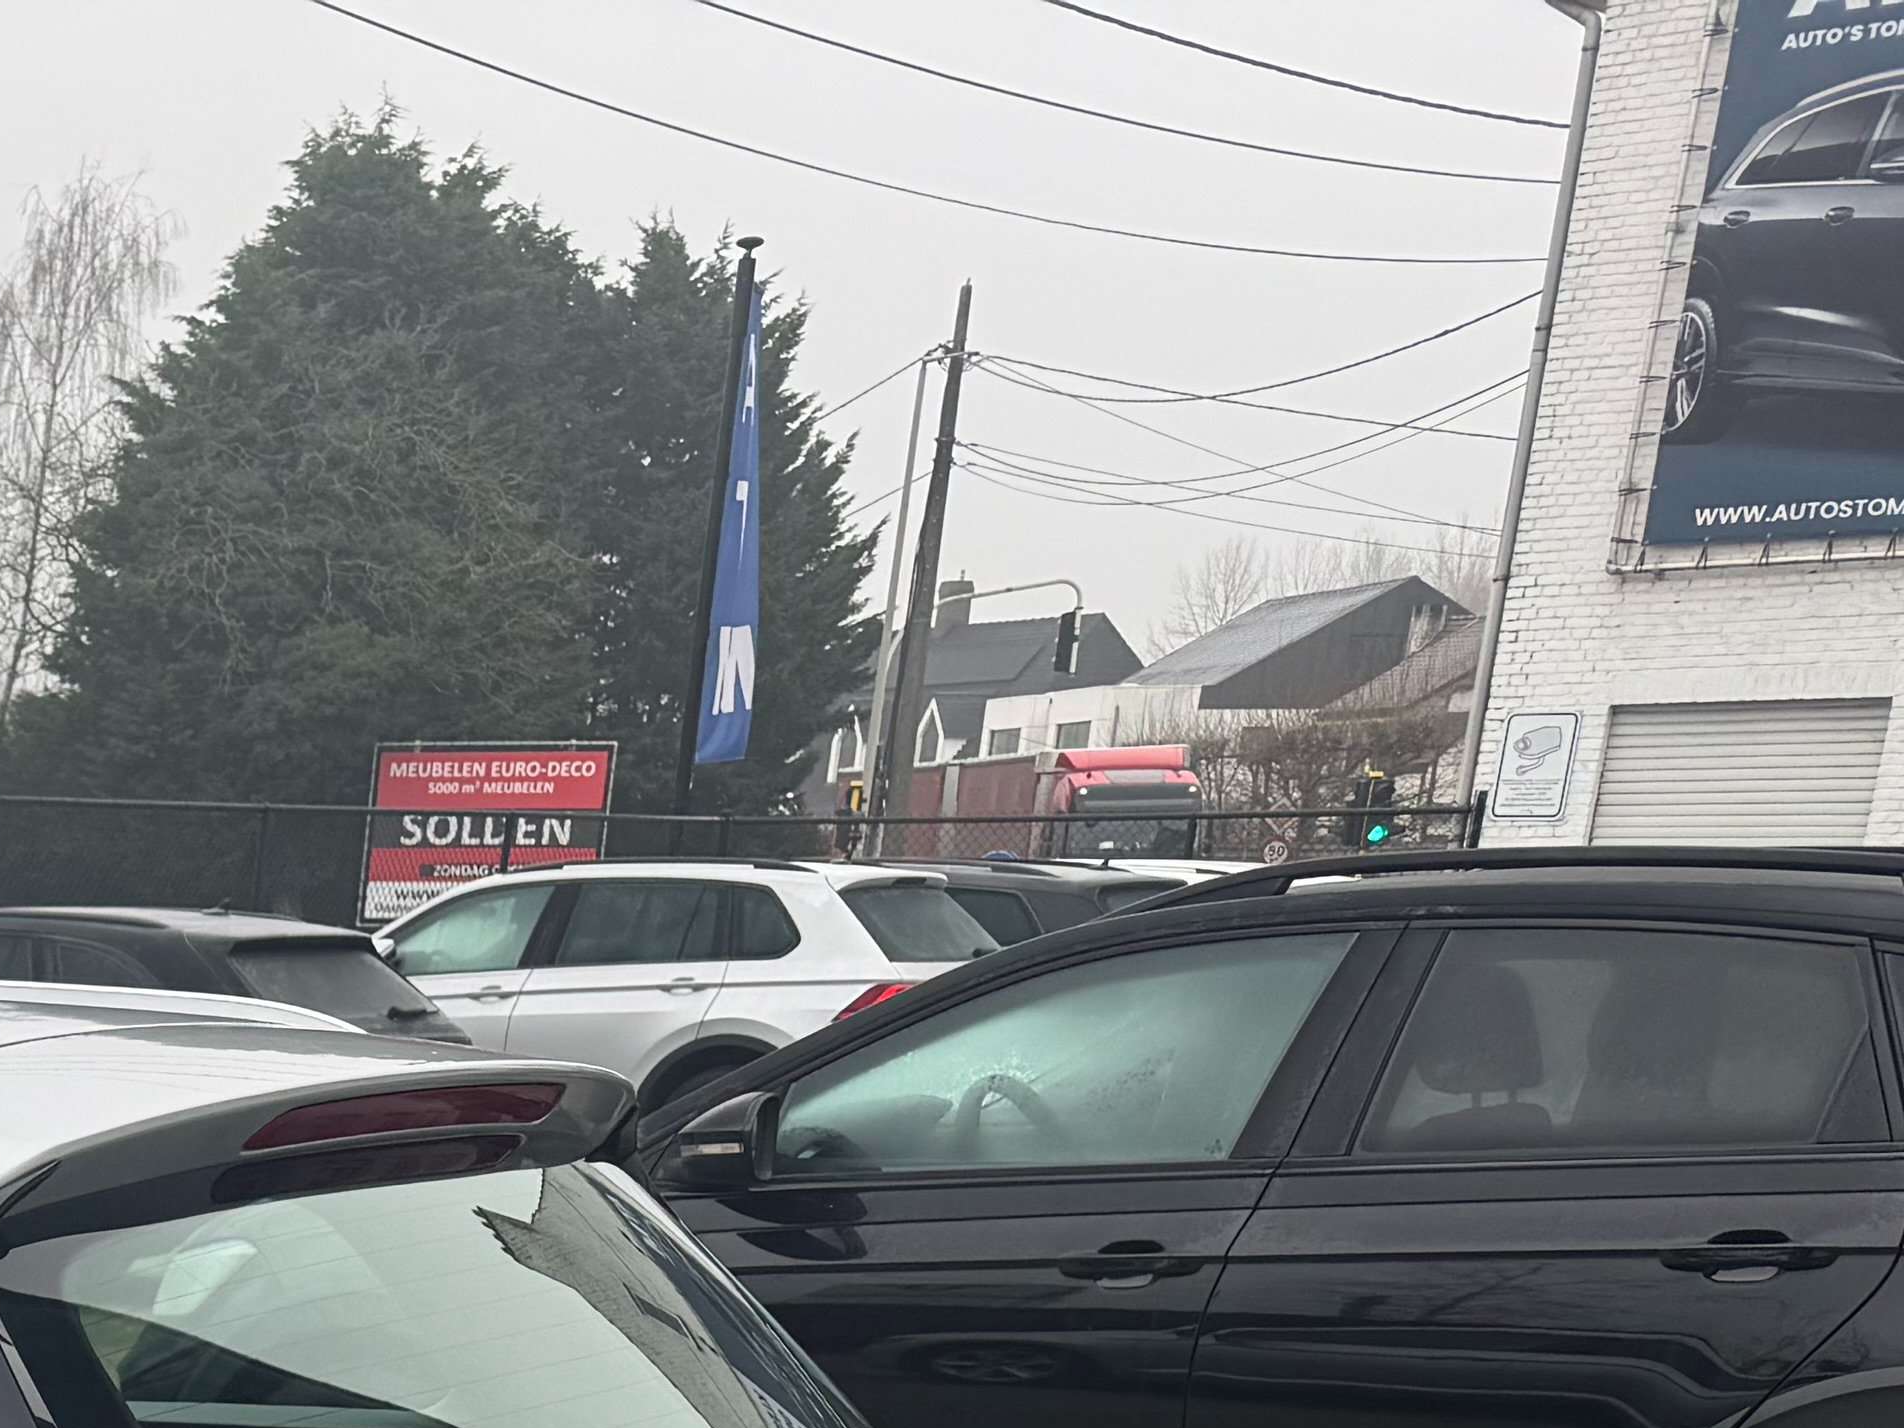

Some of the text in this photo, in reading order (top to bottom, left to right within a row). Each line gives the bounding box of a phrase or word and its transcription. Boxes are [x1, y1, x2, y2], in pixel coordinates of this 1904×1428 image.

[1780, 24, 1865, 50] AUTO'S
[1695, 498, 1904, 527] WWW.AUTOSTOM
[389, 760, 597, 778] MEUBELEN EURO-DECO
[428, 781, 459, 794] 5000
[483, 781, 554, 794] MEUBELEN
